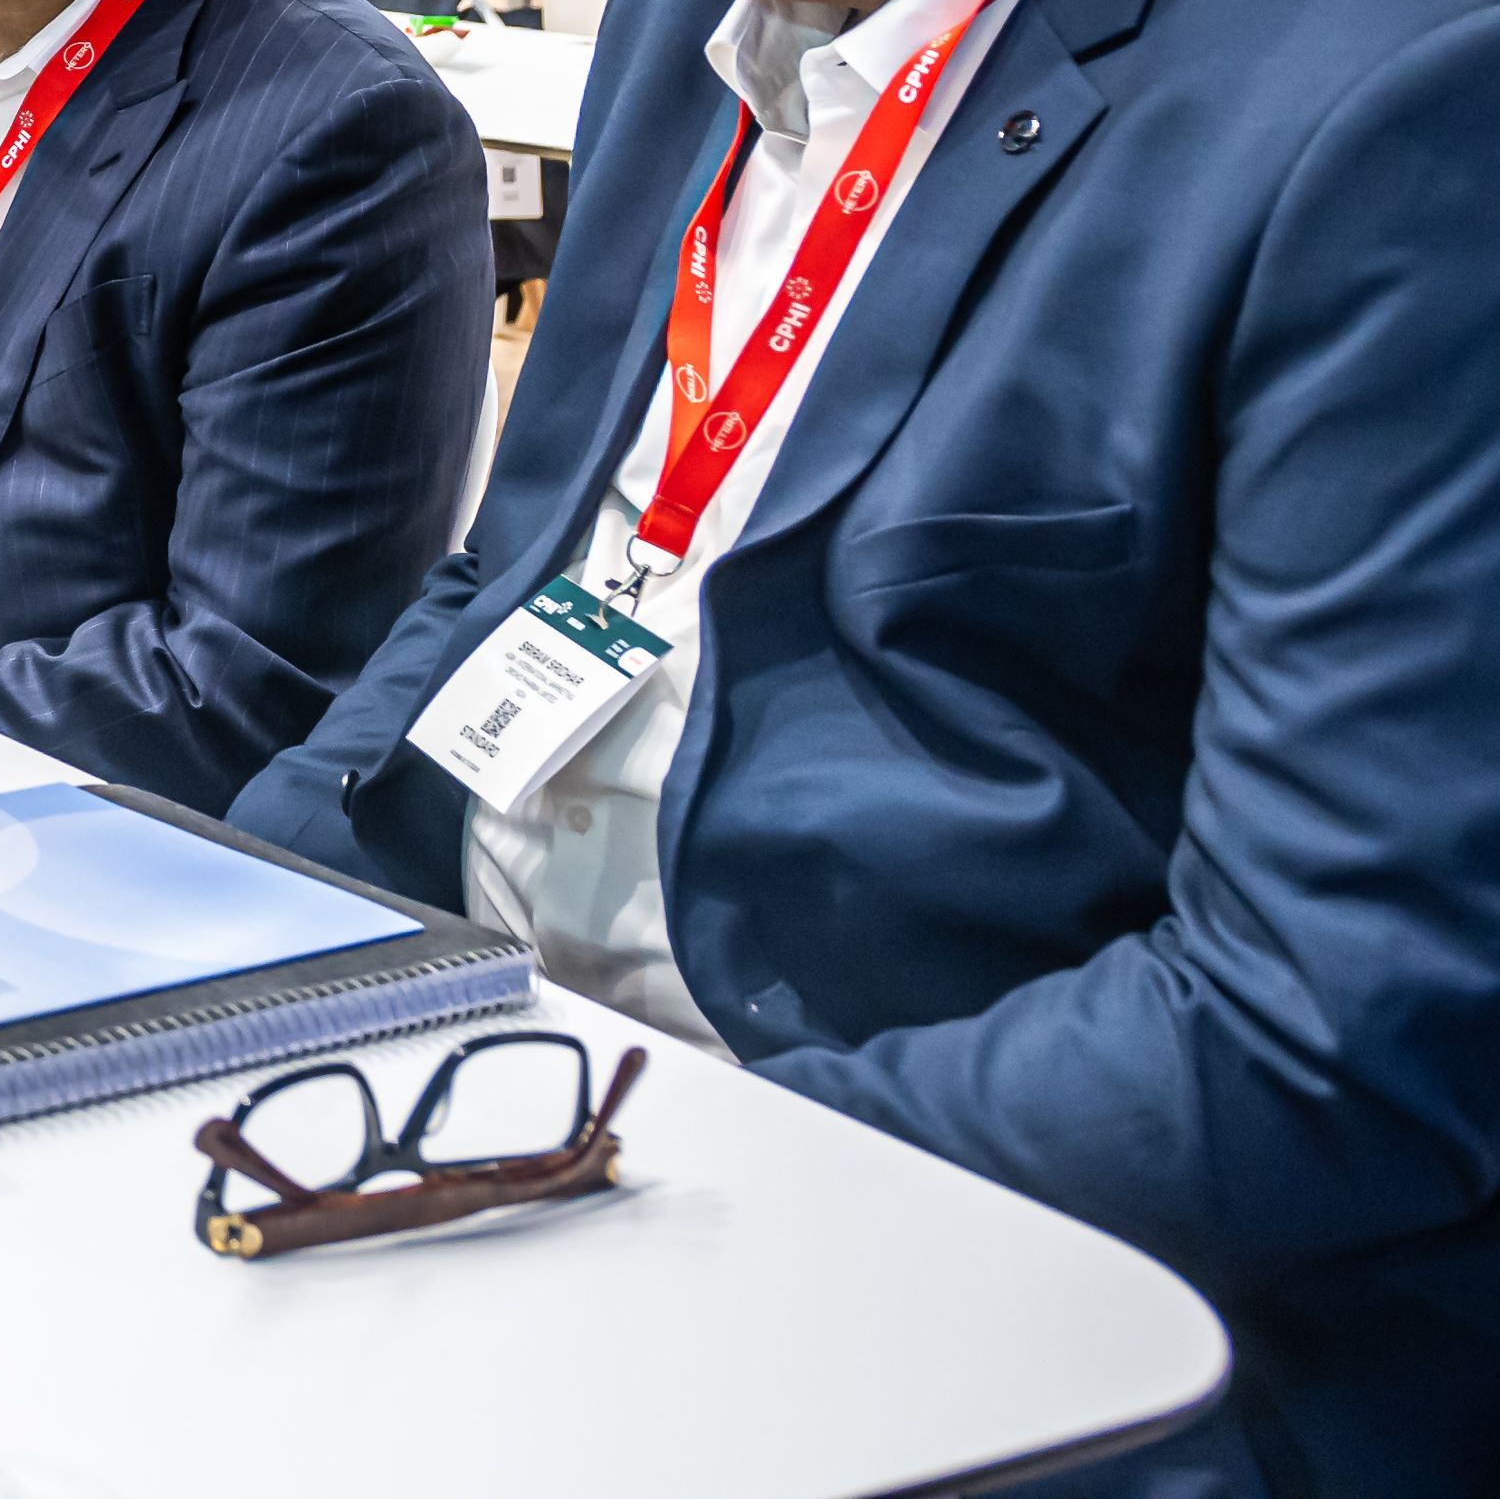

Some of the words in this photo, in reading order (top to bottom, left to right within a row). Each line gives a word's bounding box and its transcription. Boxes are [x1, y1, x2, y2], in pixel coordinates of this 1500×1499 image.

[65, 41, 92, 71] HETERO
[899, 50, 940, 104] CPHI
[1, 129, 32, 169] CPHI
[841, 170, 873, 215] HETERO
[690, 225, 708, 279] CPHI
[768, 302, 813, 353] CPHI
[709, 411, 740, 453] HETERO
